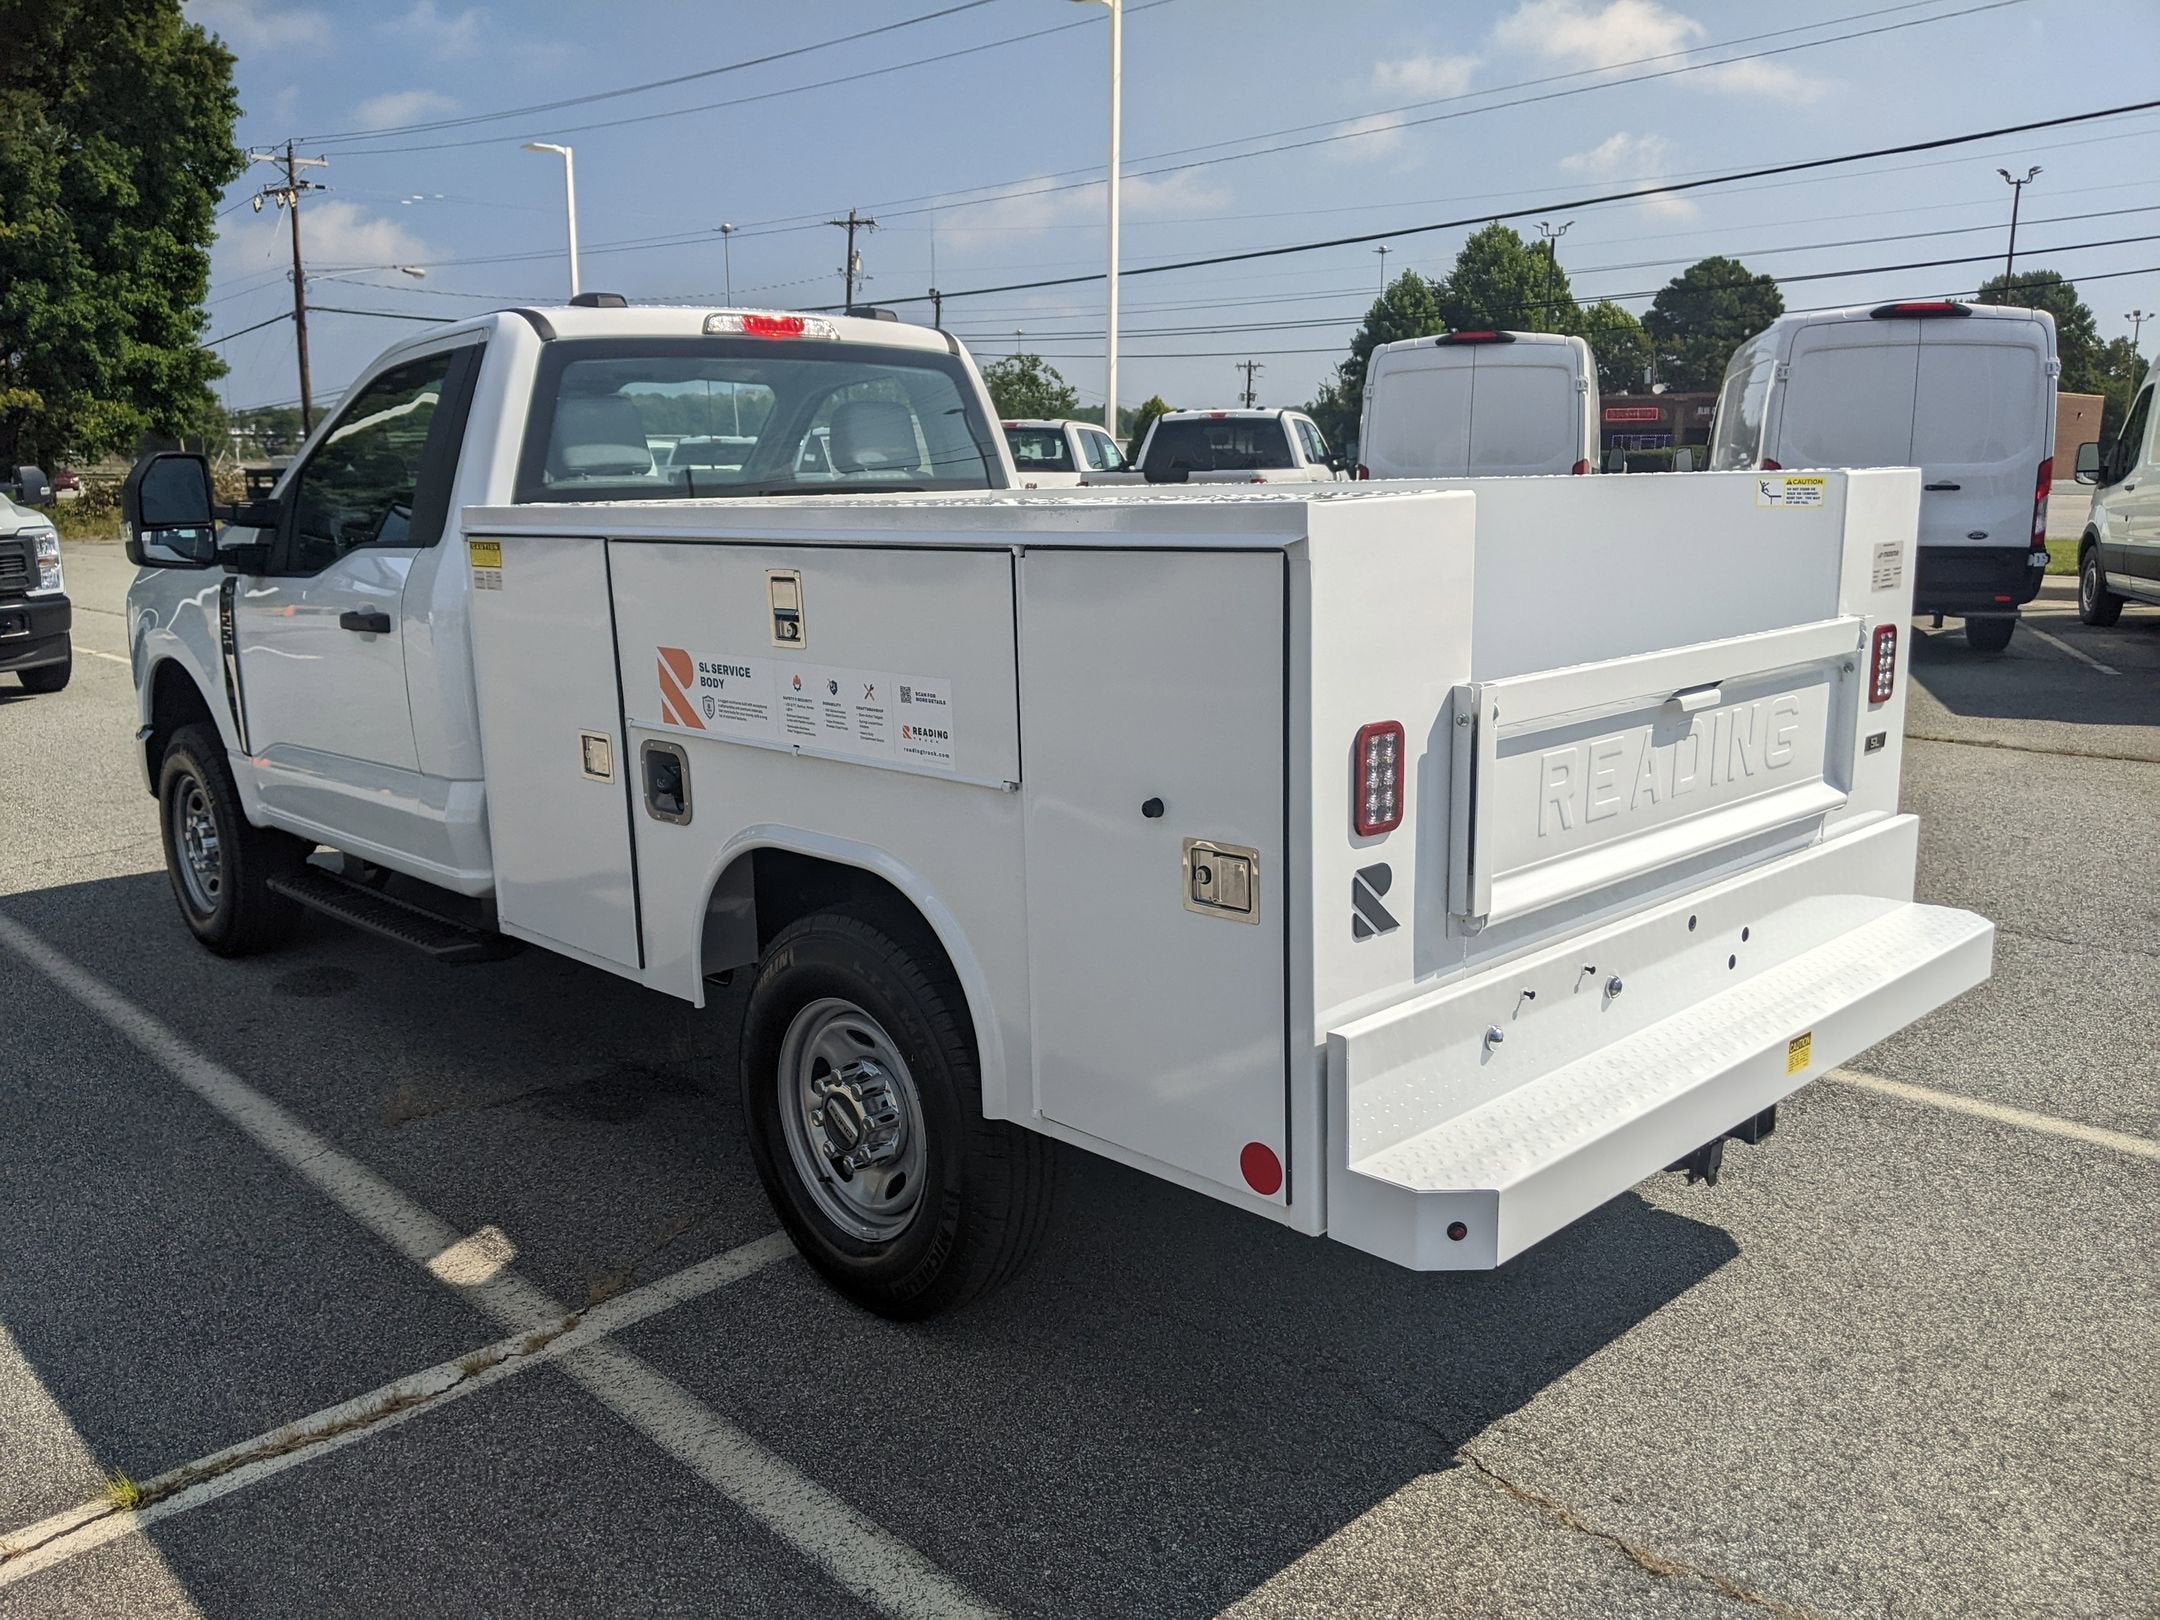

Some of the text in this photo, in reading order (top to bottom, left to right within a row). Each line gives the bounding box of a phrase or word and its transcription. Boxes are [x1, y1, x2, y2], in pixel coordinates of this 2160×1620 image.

[698, 661, 752, 678] SL SERVICE
[700, 676, 724, 689] BODY
[912, 726, 949, 740] READING
[1538, 694, 1800, 838] READING
[1790, 1036, 1811, 1053] CAUTION
